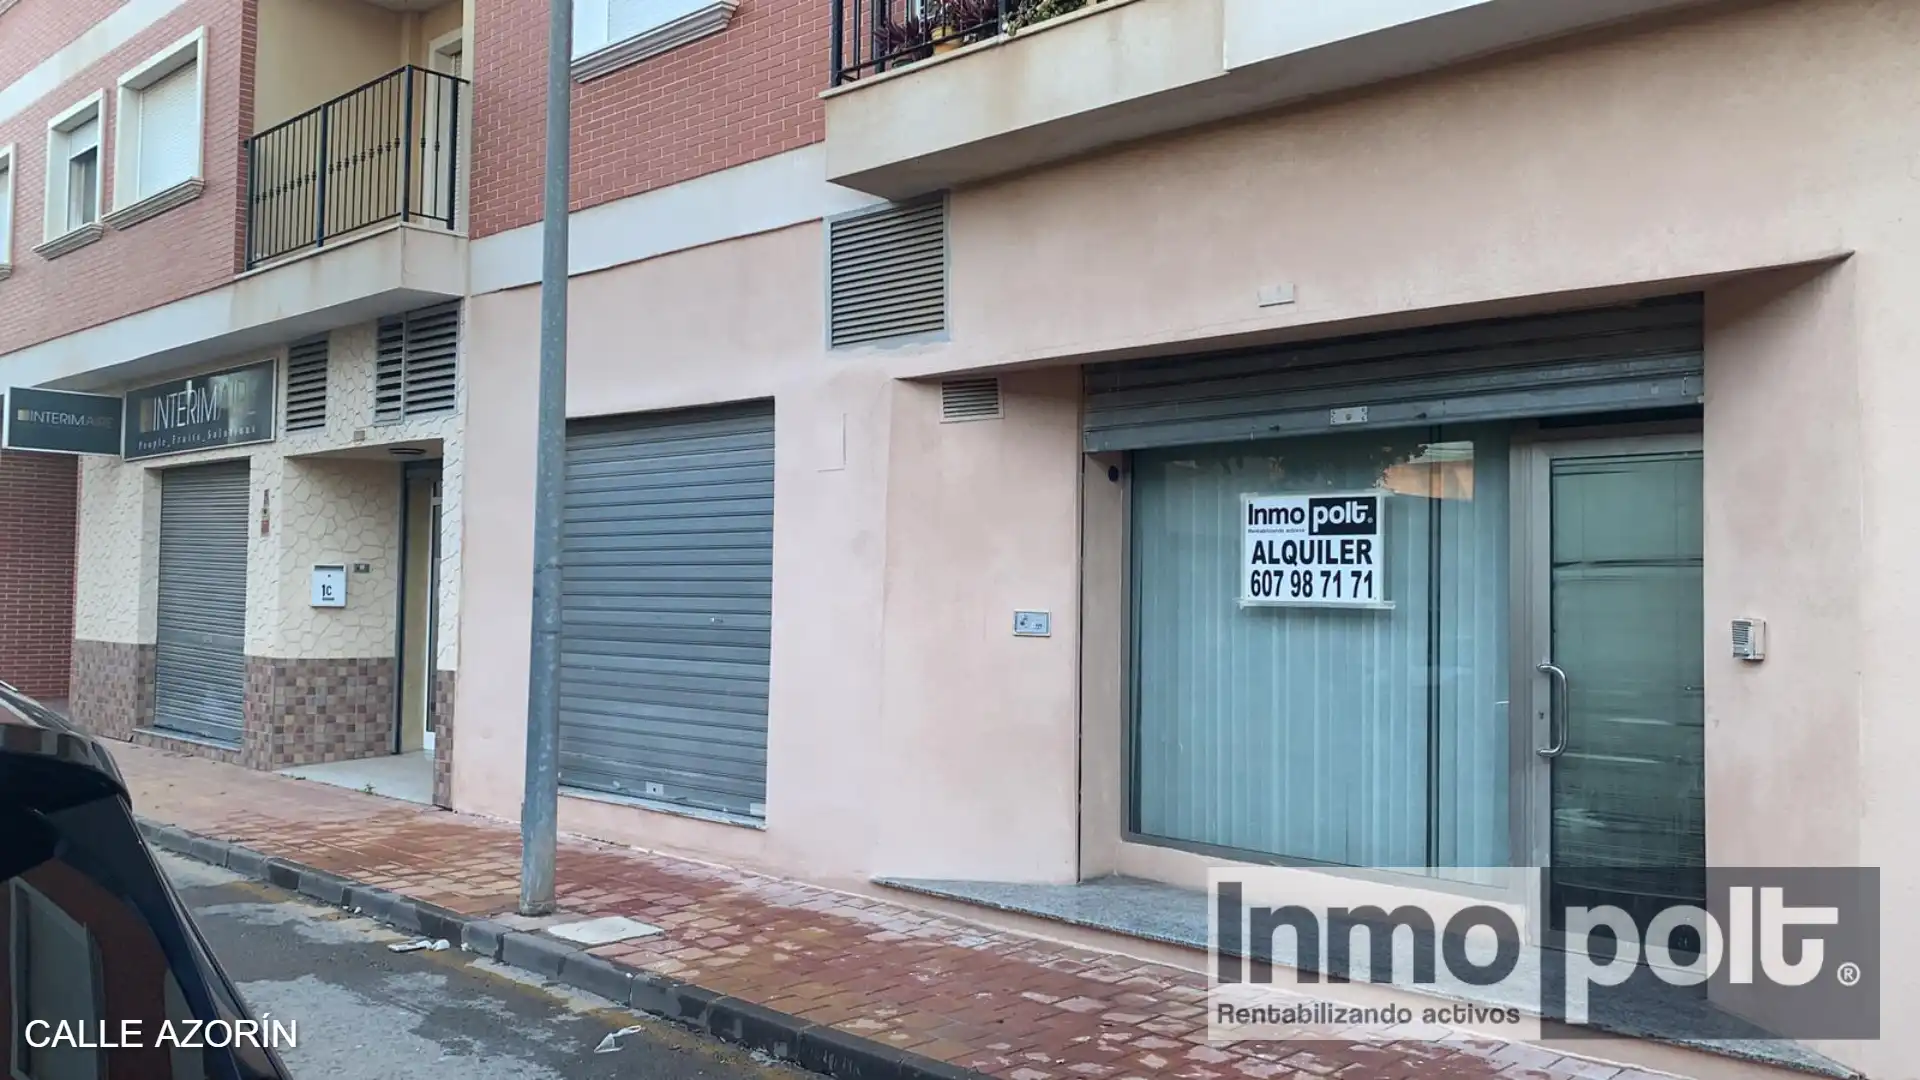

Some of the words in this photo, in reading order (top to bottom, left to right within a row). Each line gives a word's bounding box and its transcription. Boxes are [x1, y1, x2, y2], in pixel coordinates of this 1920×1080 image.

[1248, 503, 1305, 526] Inmo
[1251, 539, 1373, 567] ALQUILER
[1251, 569, 1284, 598] 607
[1290, 569, 1313, 598] 98
[1320, 569, 1341, 599] 71
[1350, 569, 1373, 599] 71
